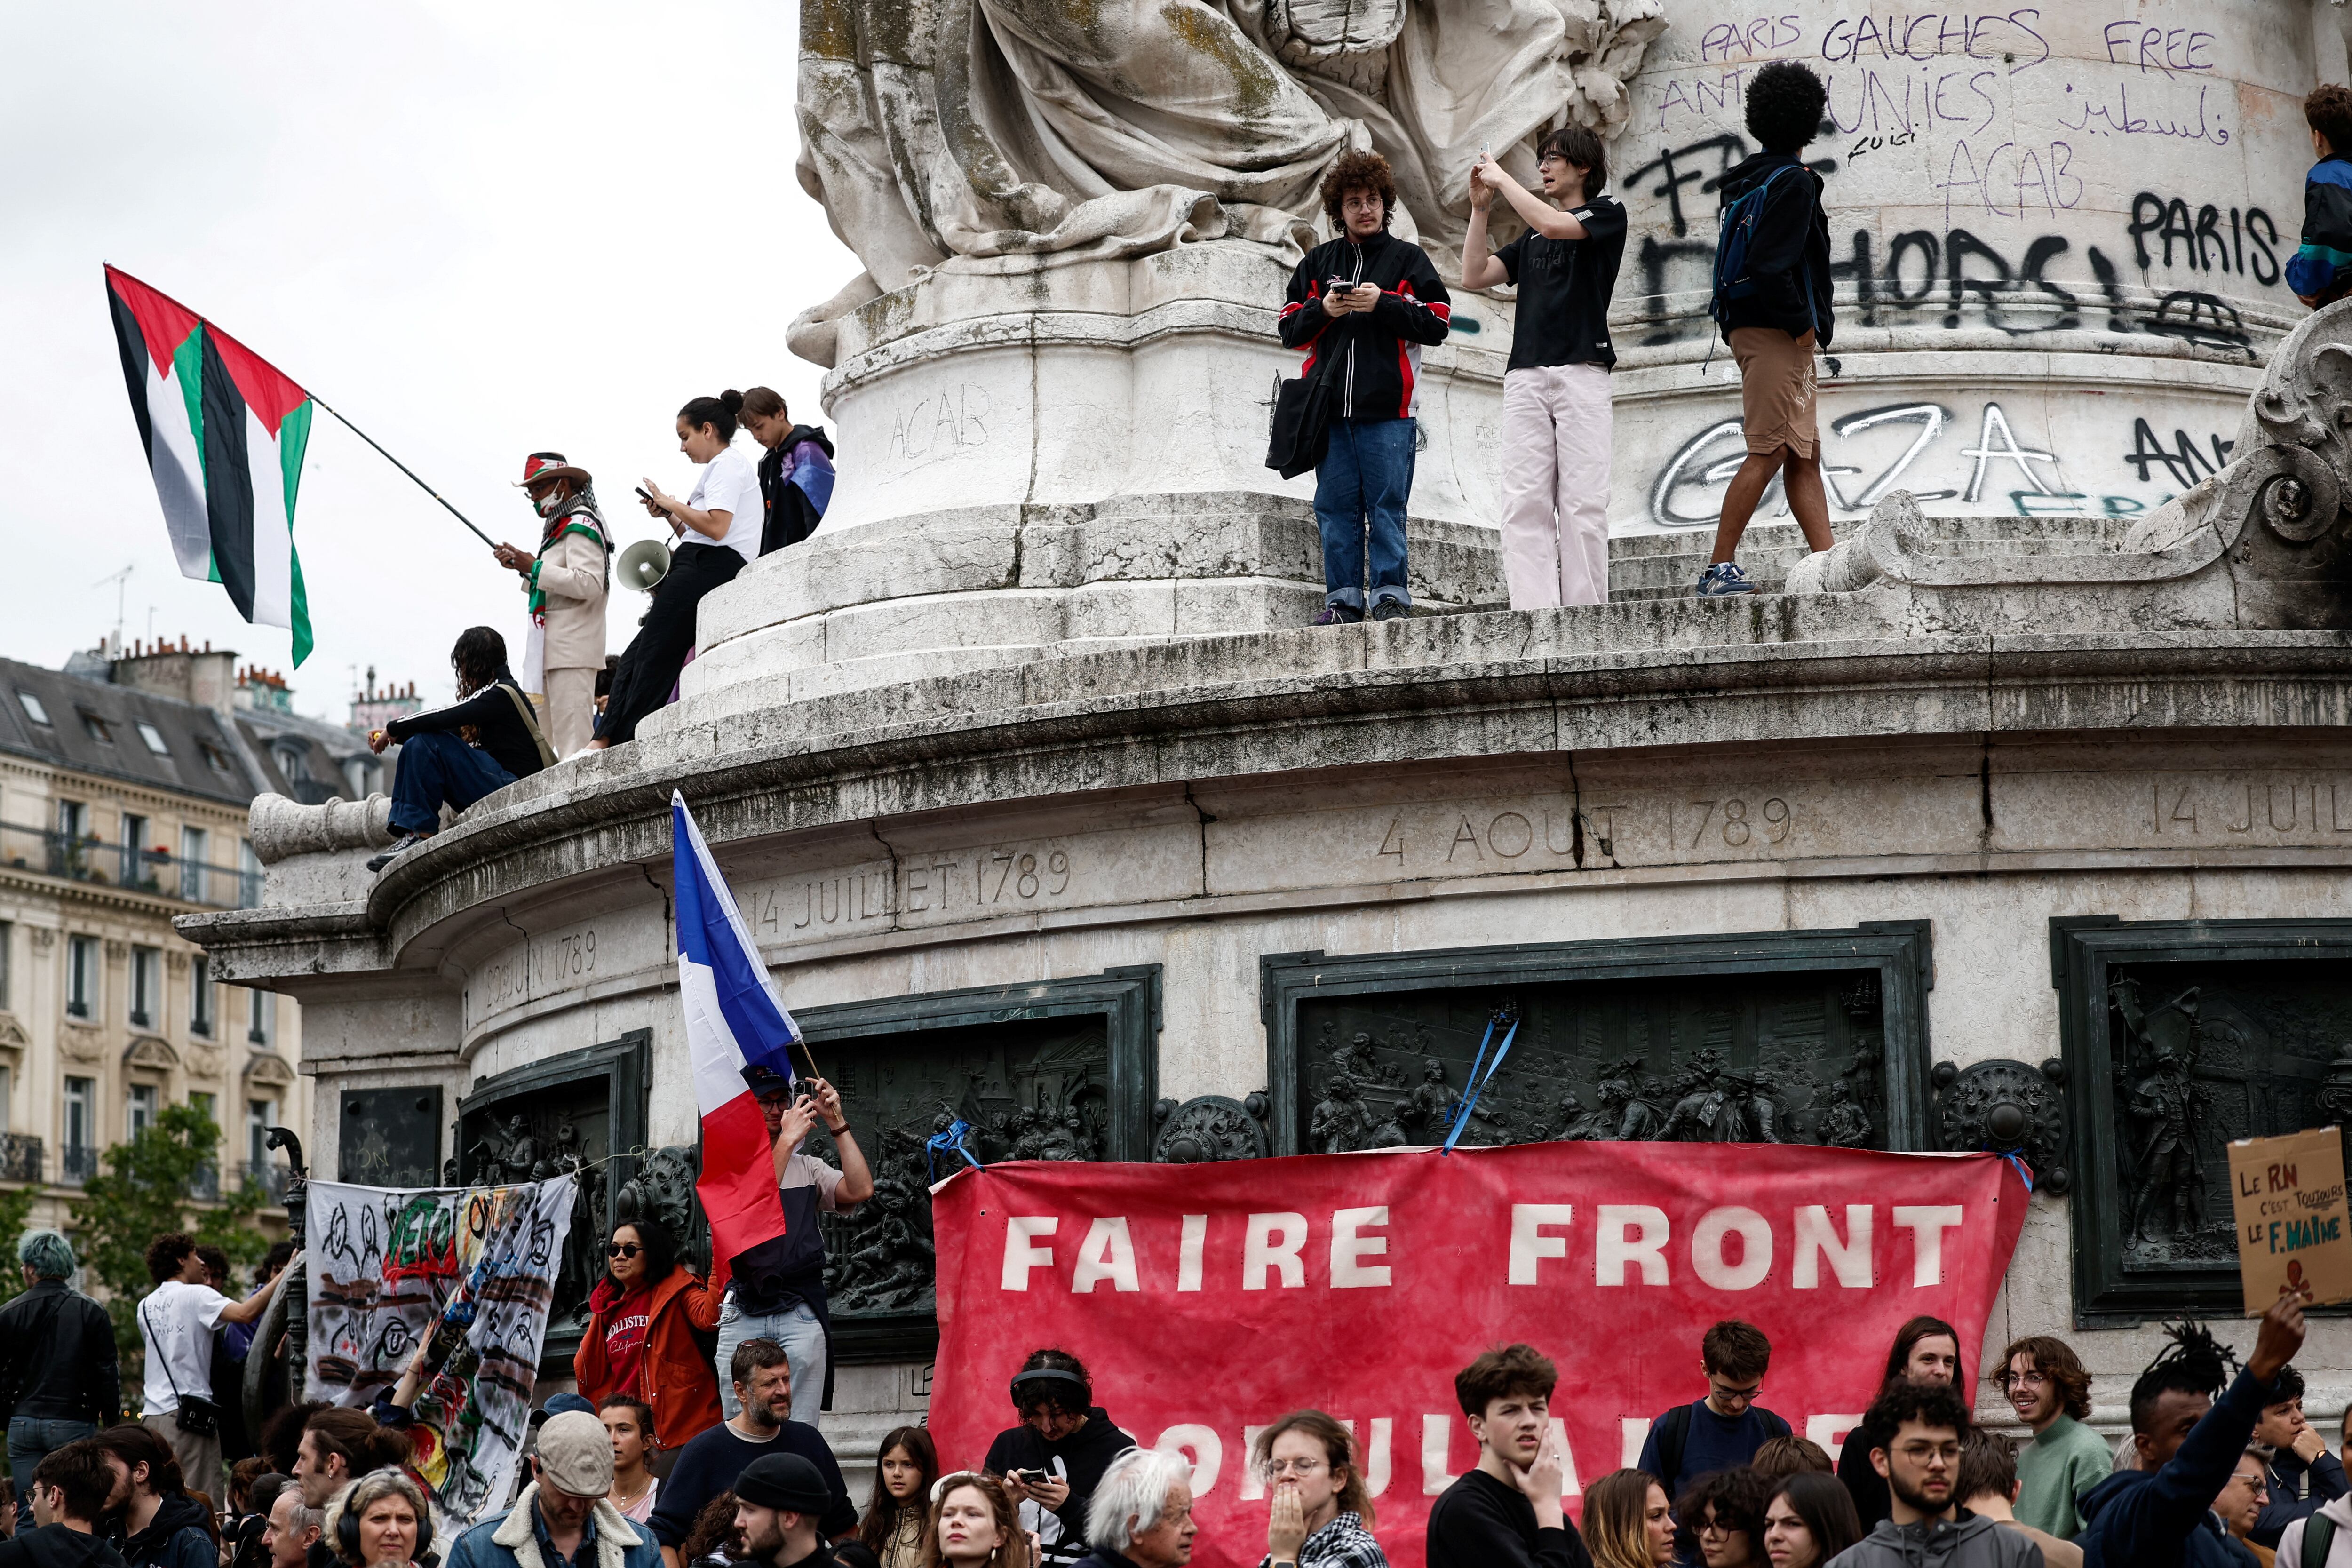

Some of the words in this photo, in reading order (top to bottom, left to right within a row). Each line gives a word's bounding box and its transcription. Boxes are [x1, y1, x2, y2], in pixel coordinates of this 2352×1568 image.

[1702, 15, 1801, 63] PARIS
[1822, 9, 2049, 75] GAUCHES
[2104, 20, 2216, 80] FREE
[1658, 69, 1751, 128] ANT
[1827, 67, 1997, 136] UNIES
[2058, 82, 2230, 146] فلسطين
[1936, 139, 2083, 233] ACAB
[2127, 192, 2280, 287] PARIS
[887, 382, 993, 463] ACAB
[1376, 817, 1405, 867] 4
[1444, 804, 1629, 864] AOUT
[1666, 796, 1790, 851] 1789
[2151, 784, 2200, 834] 14
[2226, 784, 2352, 834] JUIL
[751, 888, 779, 937] 14
[794, 861, 959, 930] JUILLET
[976, 850, 1071, 906] 1789
[555, 930, 596, 981] 1789
[2260, 1200, 2289, 1217] C'EST
[2293, 1184, 2344, 1208] TOUJOURS
[2267, 1163, 2298, 1194] RN
[1001, 1204, 1393, 1294] FAIRE
[1508, 1203, 1963, 1292] FRONT
[2248, 1224, 2264, 1245] LE
[609, 1339, 644, 1354] Californi
